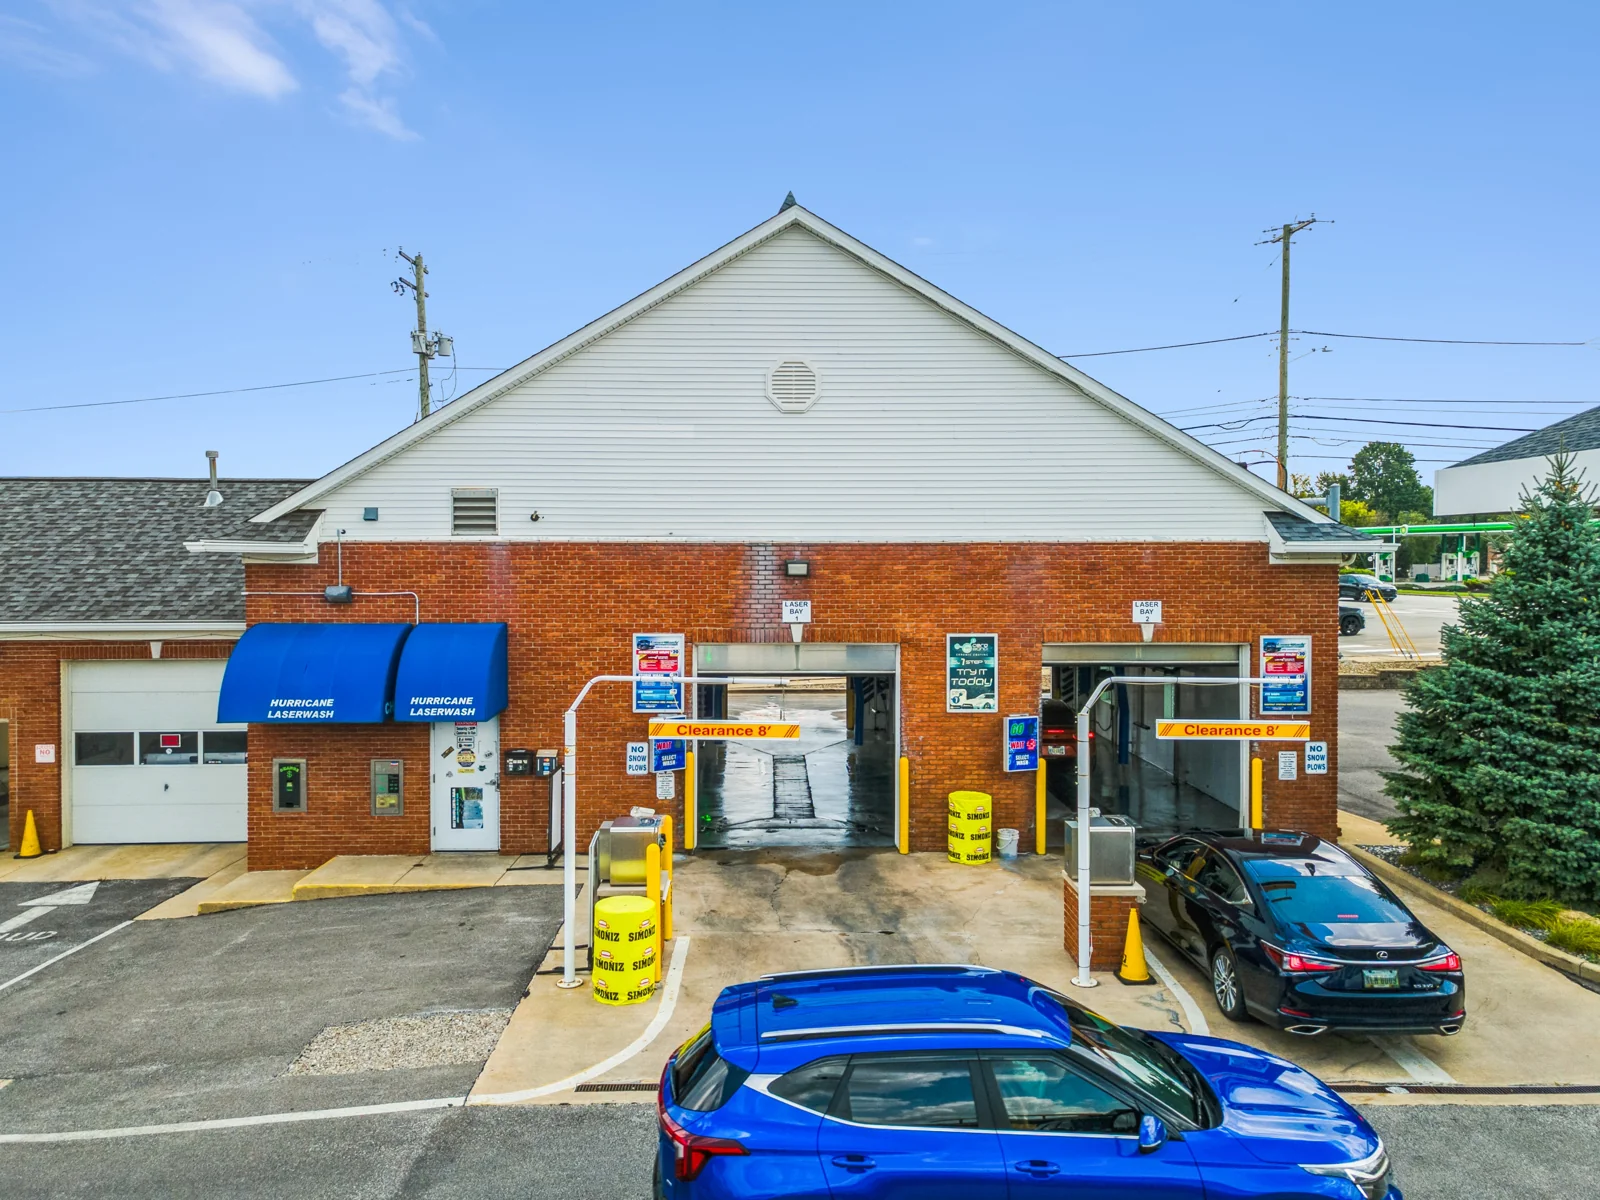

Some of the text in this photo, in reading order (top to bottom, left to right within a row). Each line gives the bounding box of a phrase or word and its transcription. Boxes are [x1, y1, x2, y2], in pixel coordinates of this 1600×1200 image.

[270, 698, 334, 707] HURRICANE
[410, 697, 474, 705] HURRICANE
[267, 710, 334, 718] LASERWASH
[410, 708, 476, 716] LASERWASH
[677, 725, 771, 736] Clearance 8'
[1184, 724, 1279, 736] Clearance 8'
[656, 741, 672, 750] WAIT
[1010, 741, 1025, 750] WAIT
